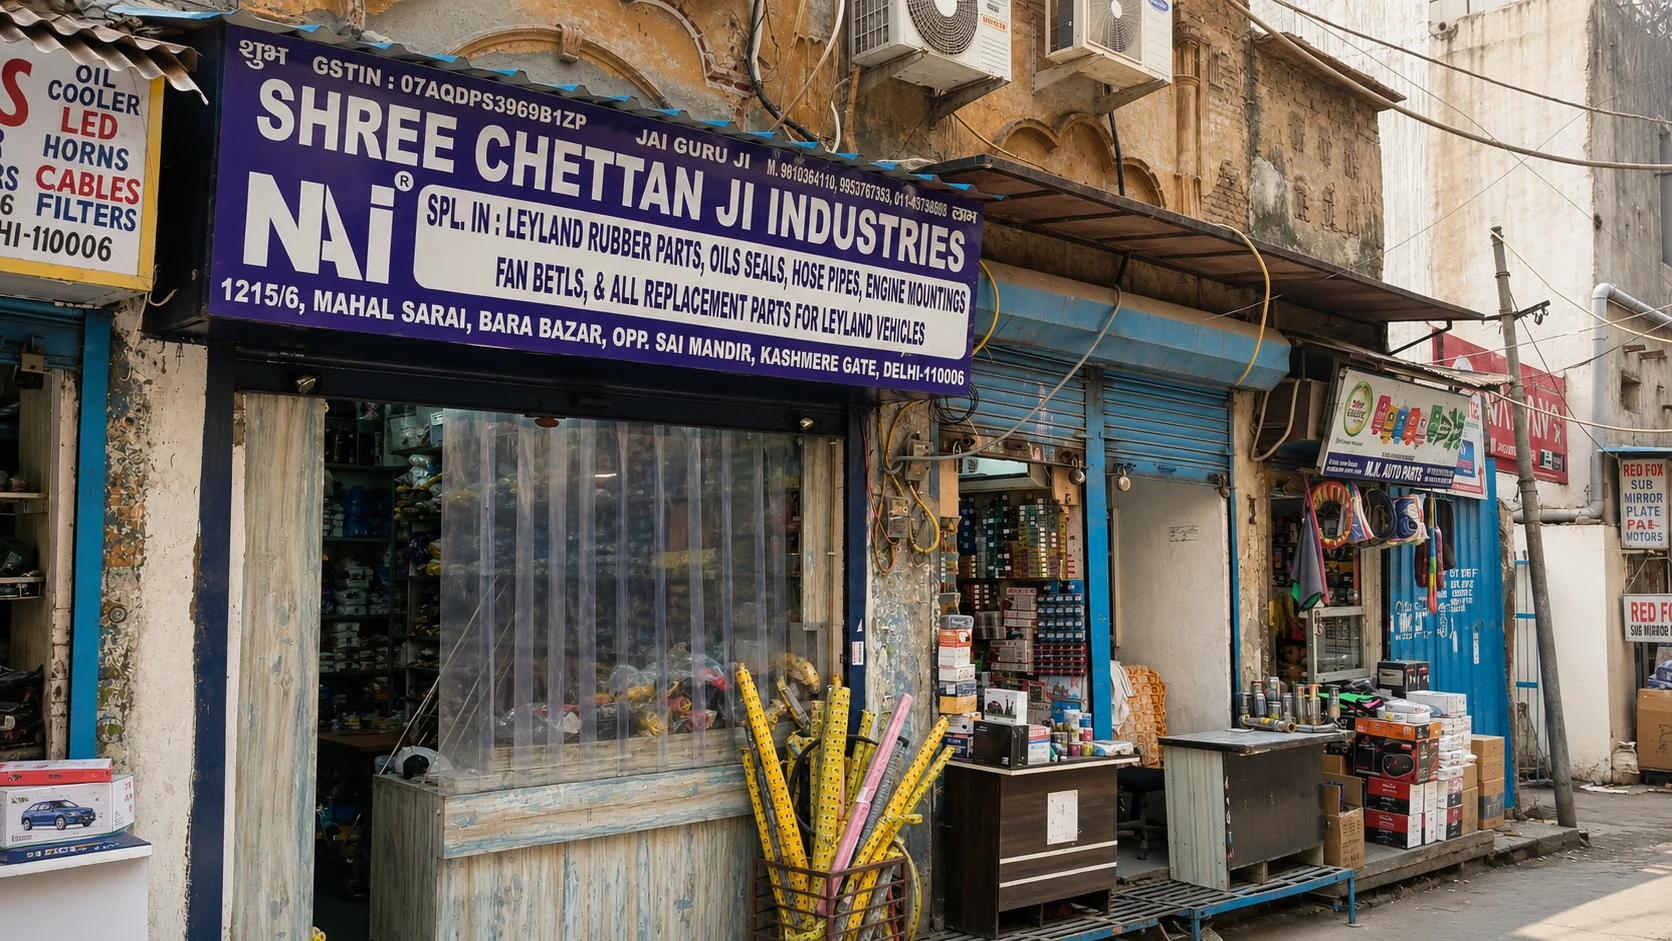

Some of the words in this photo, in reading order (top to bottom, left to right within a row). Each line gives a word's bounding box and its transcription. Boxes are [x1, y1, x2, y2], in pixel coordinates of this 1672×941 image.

[239, 40, 289, 69] शुभ
[76, 65, 116, 89] OIL
[313, 56, 382, 87] GSTIN
[401, 75, 587, 130] 07AQDPS3969B1ZP
[48, 79, 140, 116] COOLER
[60, 106, 118, 140] LED
[42, 134, 129, 171] HORNS
[636, 129, 667, 150] JAI
[673, 137, 727, 164] GURU
[733, 152, 750, 169] JI
[35, 164, 141, 205] CABLES
[257, 78, 457, 173] SHREE
[475, 124, 704, 220] CHETTAN
[715, 179, 754, 230] JI
[767, 188, 965, 272] INDUSTRIES
[767, 159, 778, 177] M.
[36, 192, 137, 232] FILTERS
[426, 193, 465, 231] SPL.
[471, 201, 491, 234] IN
[506, 207, 583, 249] LEYLAND
[587, 221, 651, 261] RUBBER
[655, 234, 704, 277] PARTS,
[709, 244, 741, 276] OILS
[744, 250, 788, 290] SEALS,
[792, 259, 825, 290] HOSE
[827, 266, 862, 302] PIPES,
[865, 273, 905, 303] ENGINE
[907, 281, 966, 314] MOUNTINGS
[495, 256, 528, 290] FAN
[532, 262, 588, 305] BETLS,
[593, 271, 605, 301] &
[609, 274, 639, 306] ALL
[643, 279, 748, 321] REPLACEMENT
[750, 296, 791, 328] PARTS
[794, 303, 819, 332] FOR
[821, 307, 873, 339] LEYLAND
[876, 315, 926, 346] VEHICLES
[221, 277, 305, 315] 1215/6,
[313, 289, 395, 320] MAHAL
[401, 300, 472, 335] SARAI,
[479, 310, 533, 337] BARA
[539, 317, 607, 350] BAZAR,
[612, 326, 649, 350] OPP.
[655, 332, 684, 354] SAI
[688, 336, 755, 366] MANDIR,
[760, 345, 839, 372] KASHMERE
[843, 357, 880, 380] GATE,
[883, 361, 965, 386] DELHI-110006
[1364, 461, 1381, 477] M.K.
[1381, 463, 1402, 479] AUTO
[1401, 465, 1423, 481] PARTS
[1623, 464, 1643, 477] RED
[1645, 463, 1663, 477] FOX
[1631, 479, 1653, 490] SUB
[1624, 493, 1663, 503] MIRROR
[1627, 506, 1660, 517] PLATE
[1626, 532, 1663, 542] MOTORS
[1631, 601, 1656, 623] RED
